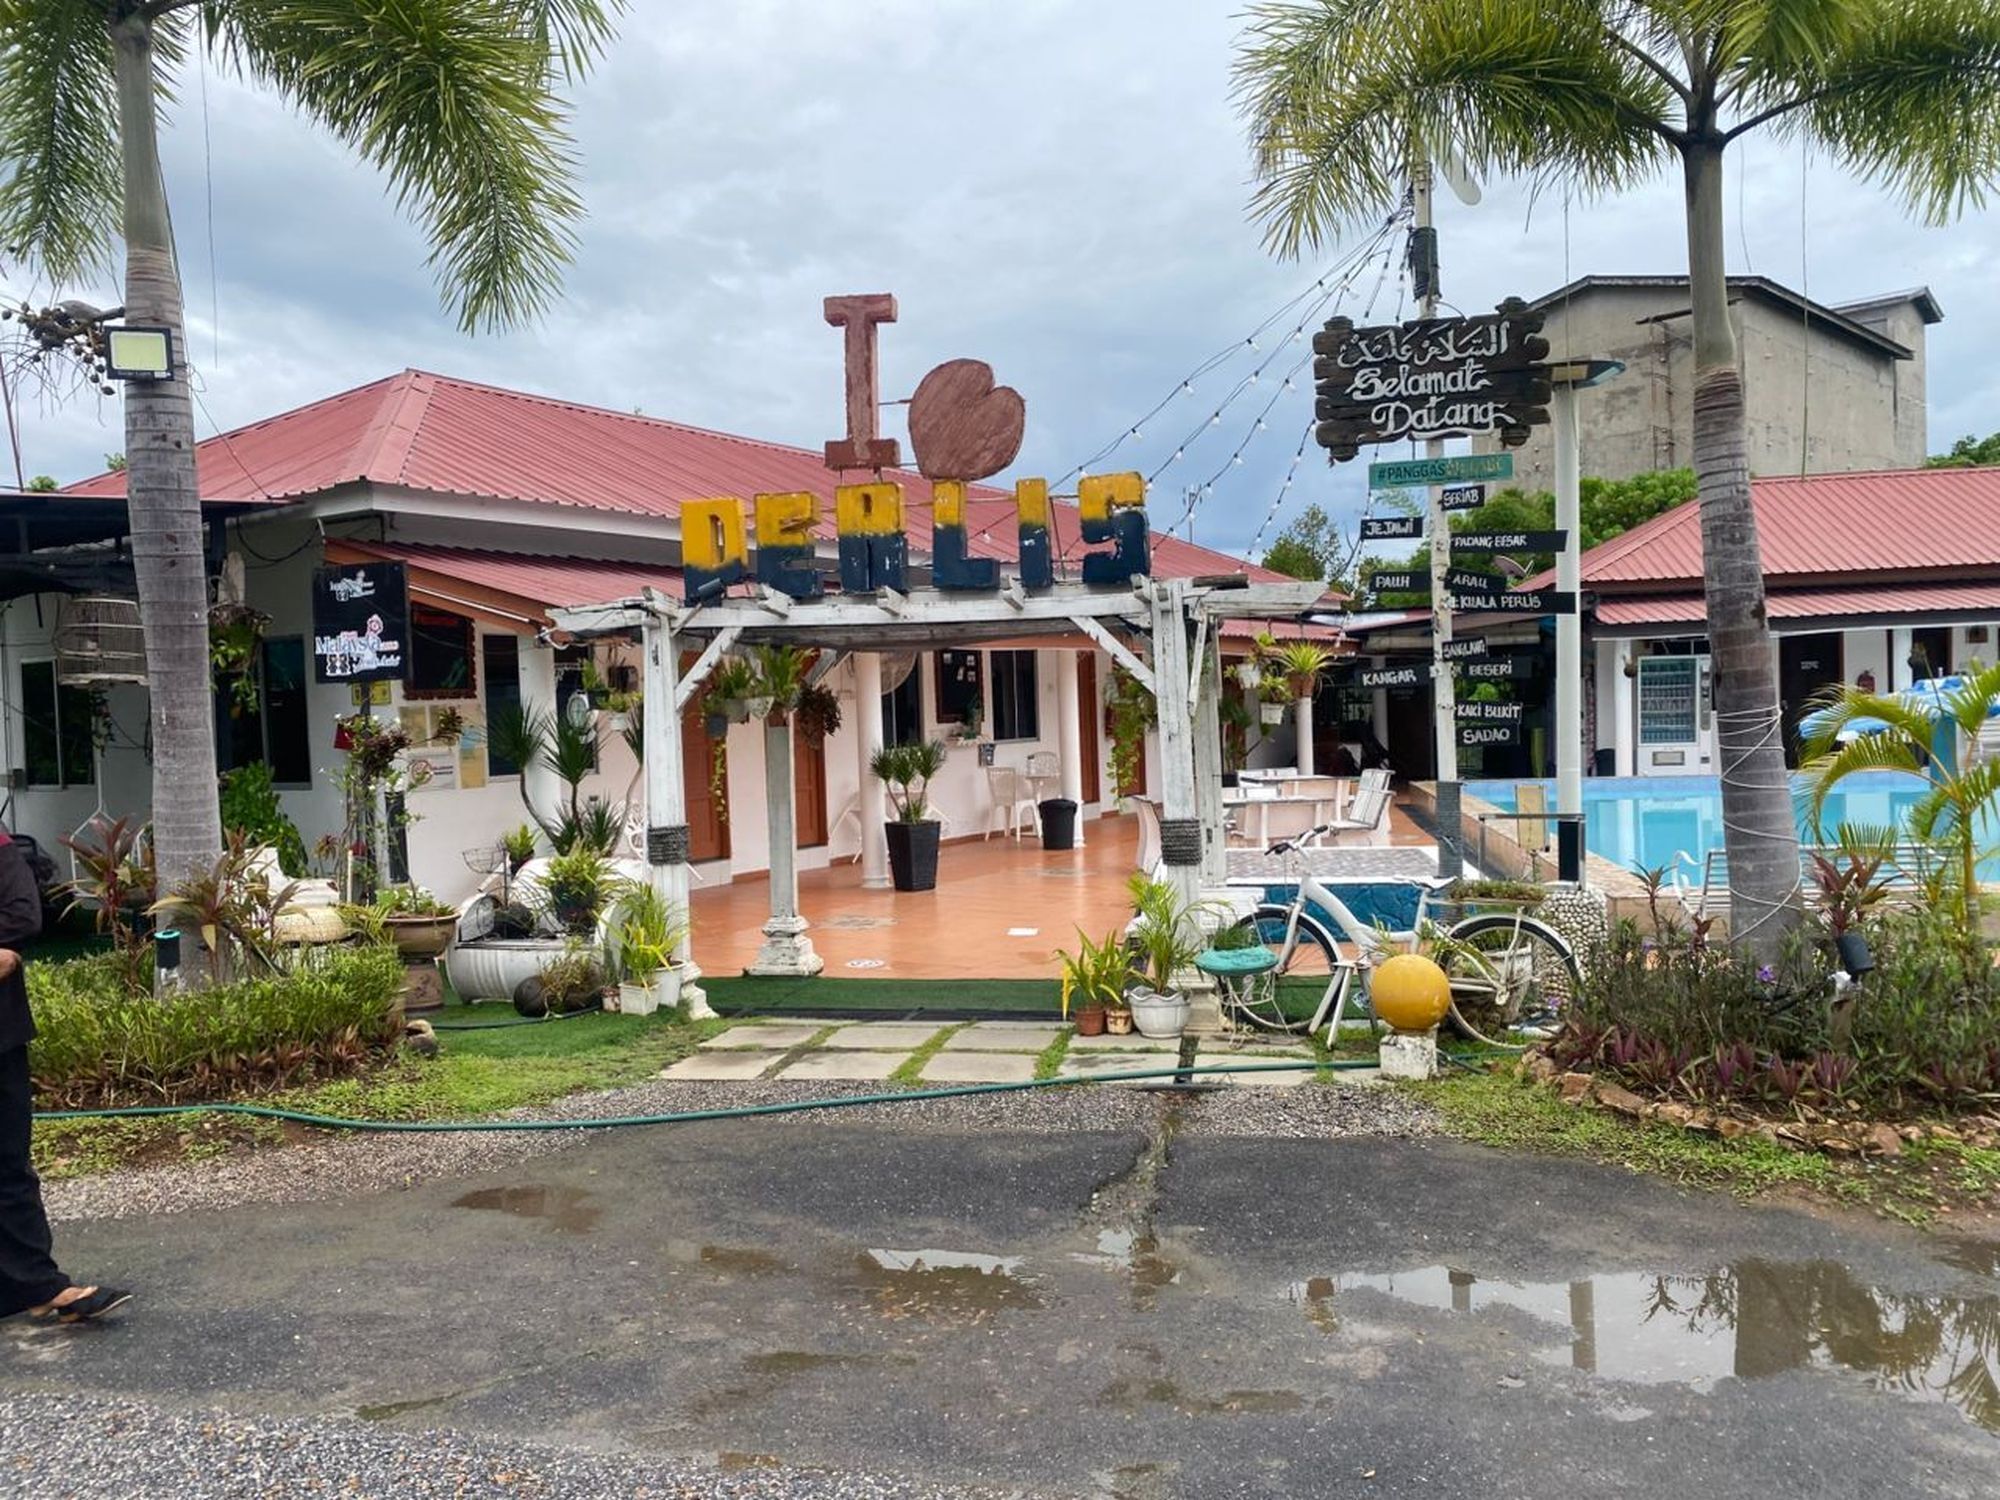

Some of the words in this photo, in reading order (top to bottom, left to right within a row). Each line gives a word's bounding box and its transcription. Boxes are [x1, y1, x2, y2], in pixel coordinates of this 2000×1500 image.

[823, 293, 899, 471] I
[1344, 358, 1493, 401] Selamat
[1371, 396, 1517, 439] Datang
[1454, 537, 1492, 548] PADANG
[1495, 536, 1527, 547] BESAR
[1452, 575, 1488, 589] ARAU
[1362, 669, 1417, 686] KANGAR
[1462, 727, 1510, 744] SADAO
